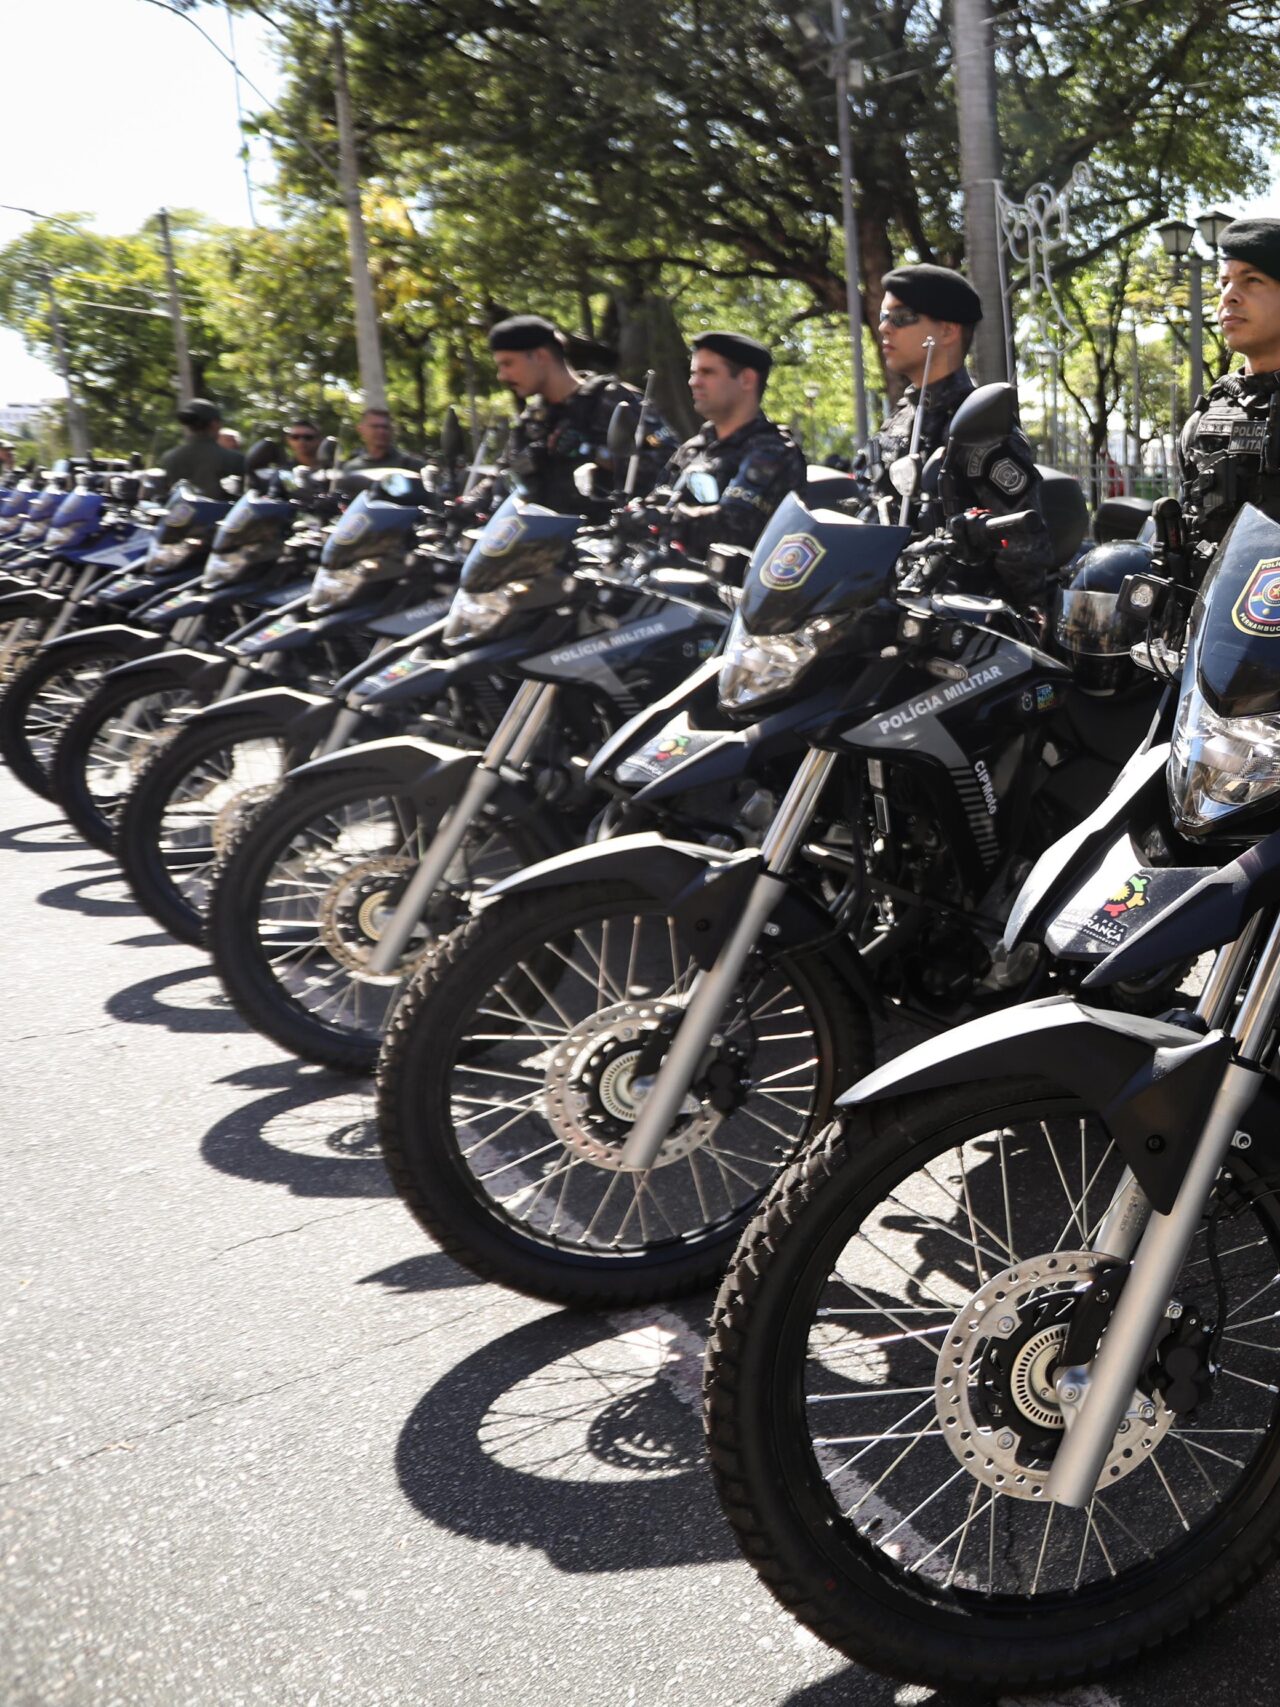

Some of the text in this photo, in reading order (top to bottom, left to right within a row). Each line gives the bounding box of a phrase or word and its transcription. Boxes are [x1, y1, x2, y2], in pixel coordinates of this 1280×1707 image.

[1230, 440, 1261, 451] MILITA
[550, 622, 666, 666] POLÍCIA MILITAR
[878, 695, 943, 735] POLÍCIA
[943, 665, 1003, 701] MILITAR
[974, 760, 997, 815] CIPMoto
